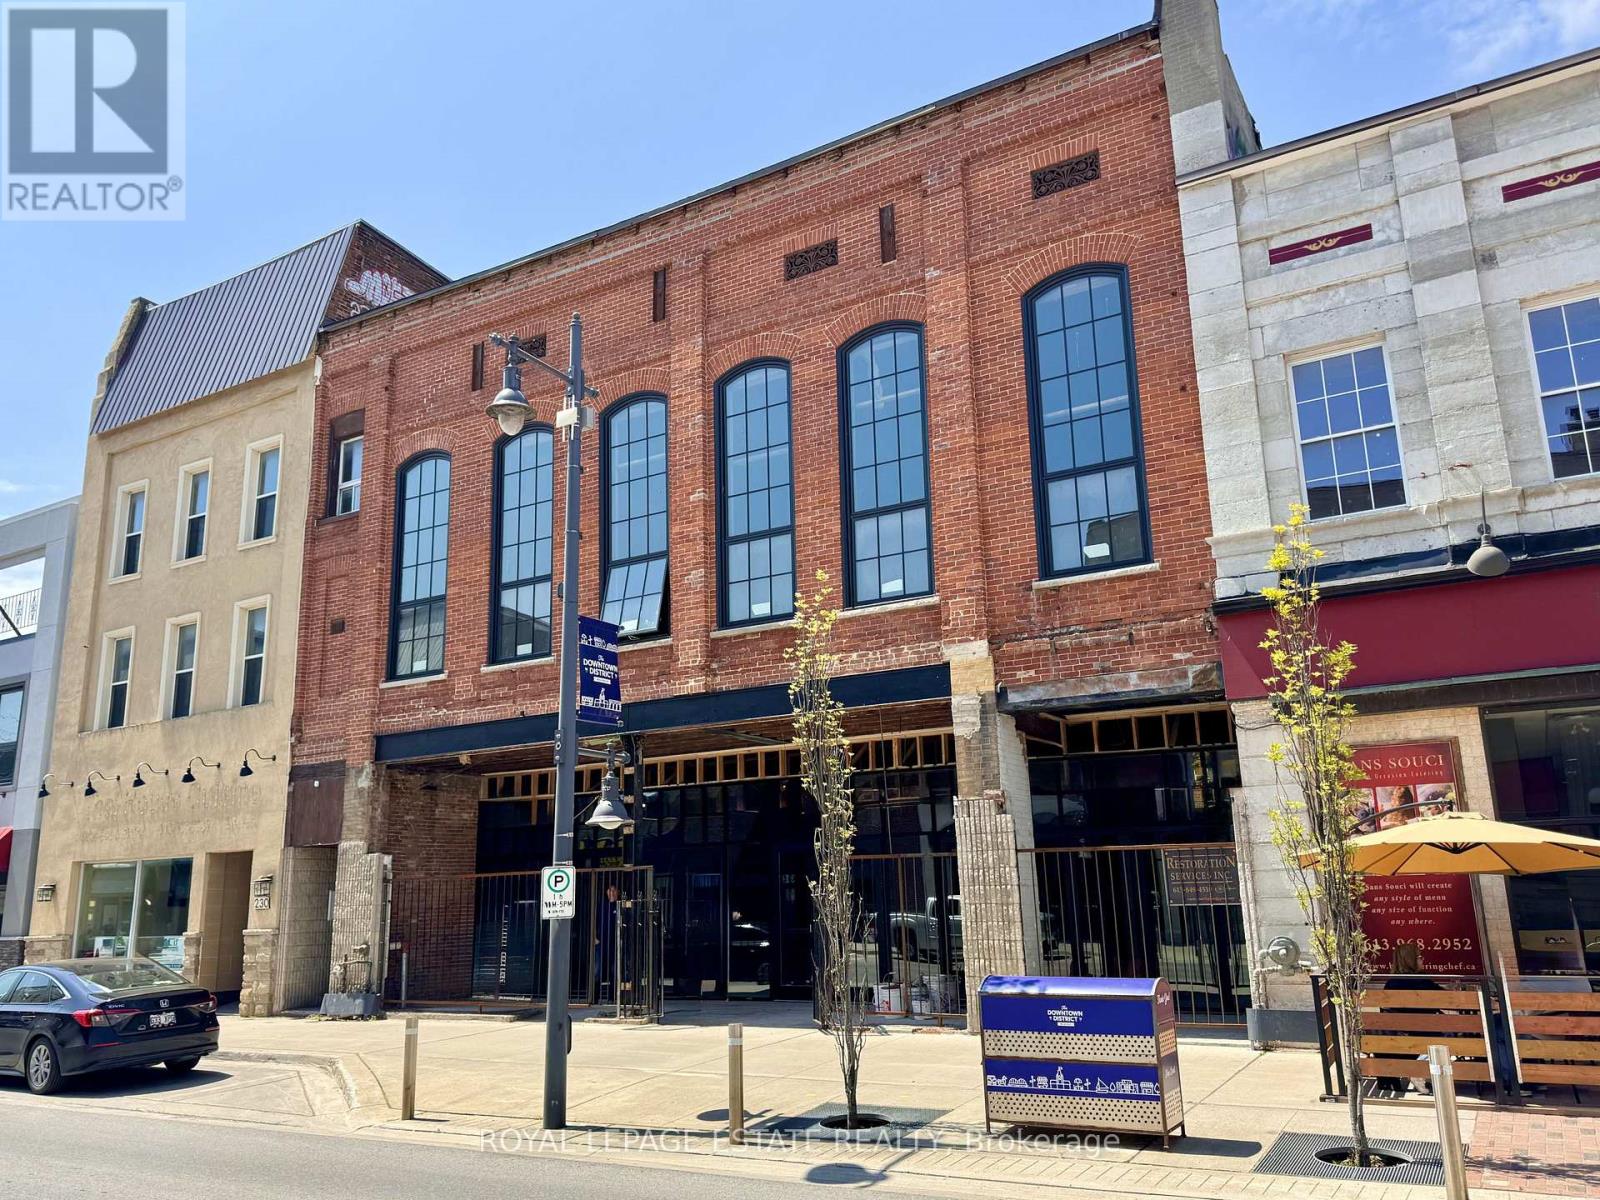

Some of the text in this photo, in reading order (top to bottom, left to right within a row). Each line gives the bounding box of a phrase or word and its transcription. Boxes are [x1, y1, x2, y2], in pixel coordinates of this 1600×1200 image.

[583, 658, 618, 672] DOWNTOWN
[589, 667, 614, 679] DISTRICT
[1388, 754, 1445, 769] SOUCI
[554, 875, 564, 888] P
[255, 898, 269, 909] 230
[1390, 919, 1405, 927] any
